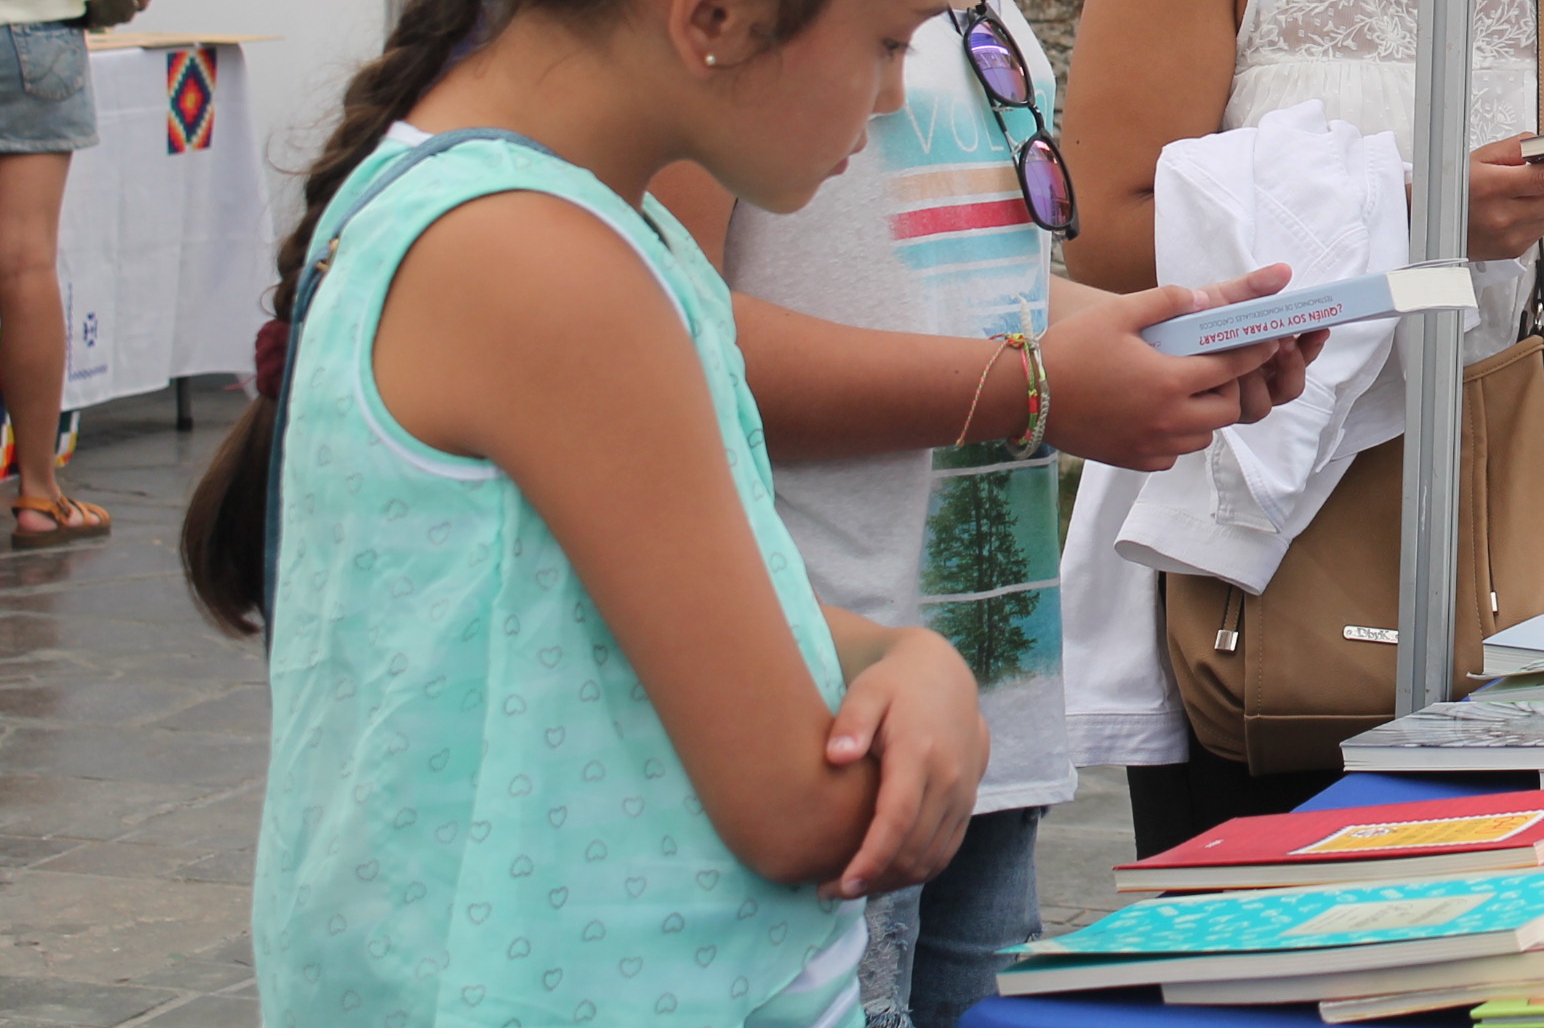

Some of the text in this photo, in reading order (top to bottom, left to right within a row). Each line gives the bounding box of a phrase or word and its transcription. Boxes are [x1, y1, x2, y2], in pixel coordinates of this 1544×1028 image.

[1199, 303, 1343, 346] ¿QUIÉN SOY YO PARA JUZGAR?
